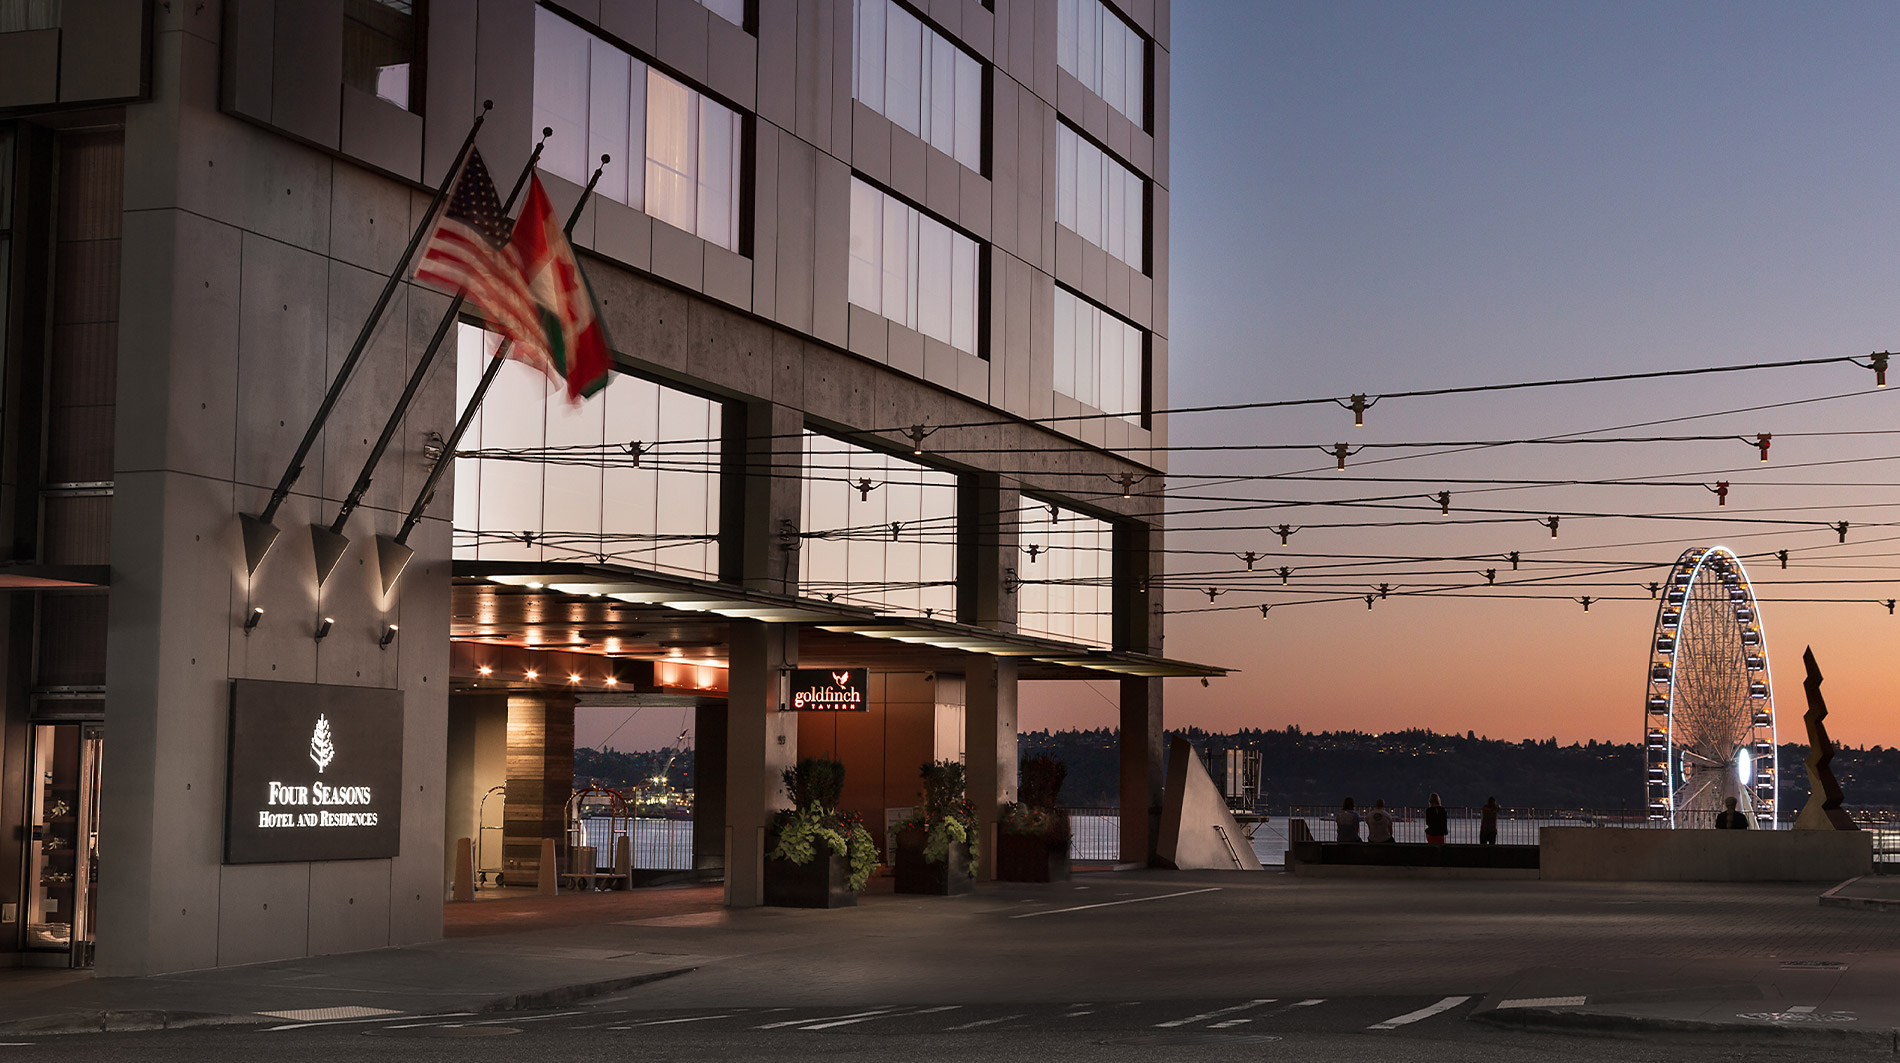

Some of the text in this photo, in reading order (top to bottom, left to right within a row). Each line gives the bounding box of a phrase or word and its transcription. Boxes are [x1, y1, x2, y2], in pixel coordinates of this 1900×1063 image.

[794, 686, 861, 708] goldfinch
[268, 781, 371, 805] FOUR SEASONS
[258, 810, 378, 828] HOTEL AND RESIDENCES
